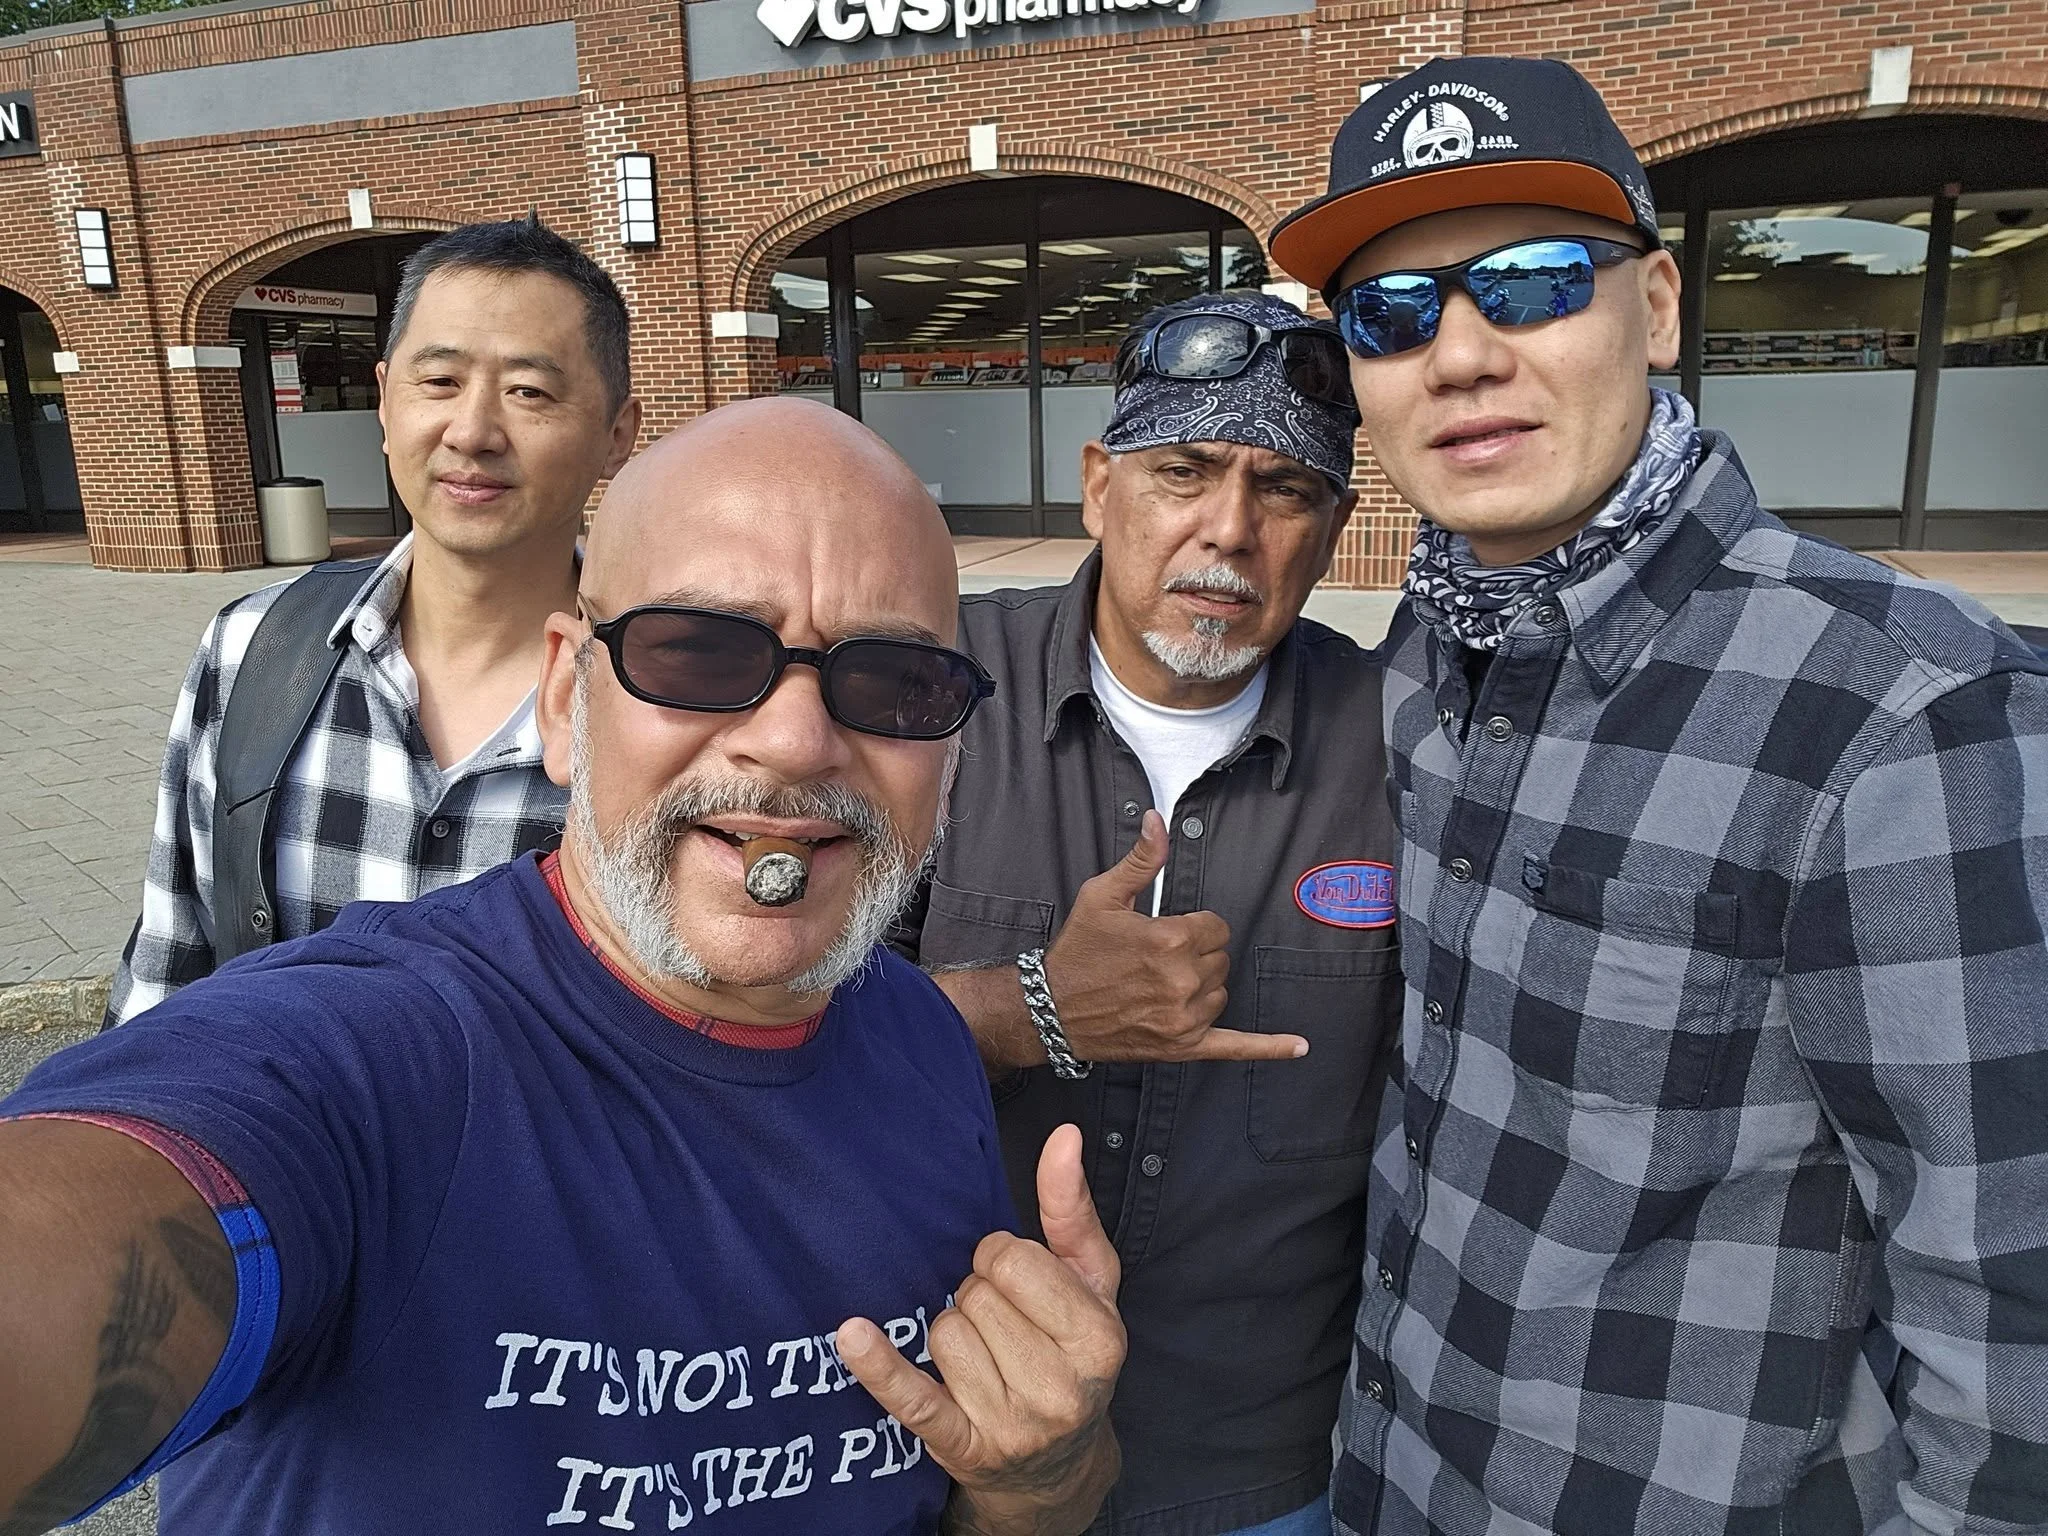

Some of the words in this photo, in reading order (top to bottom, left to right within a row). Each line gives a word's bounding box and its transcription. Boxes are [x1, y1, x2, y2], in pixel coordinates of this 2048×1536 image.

[955, 0, 1198, 38] phar
[268, 288, 296, 304] CVS
[298, 293, 345, 309] pharmacy
[485, 1332, 630, 1416] IT'S
[636, 1346, 754, 1416] NOT
[547, 1456, 694, 1531] IT'S
[692, 1434, 813, 1515] THE
[830, 1414, 922, 1483] PIL
